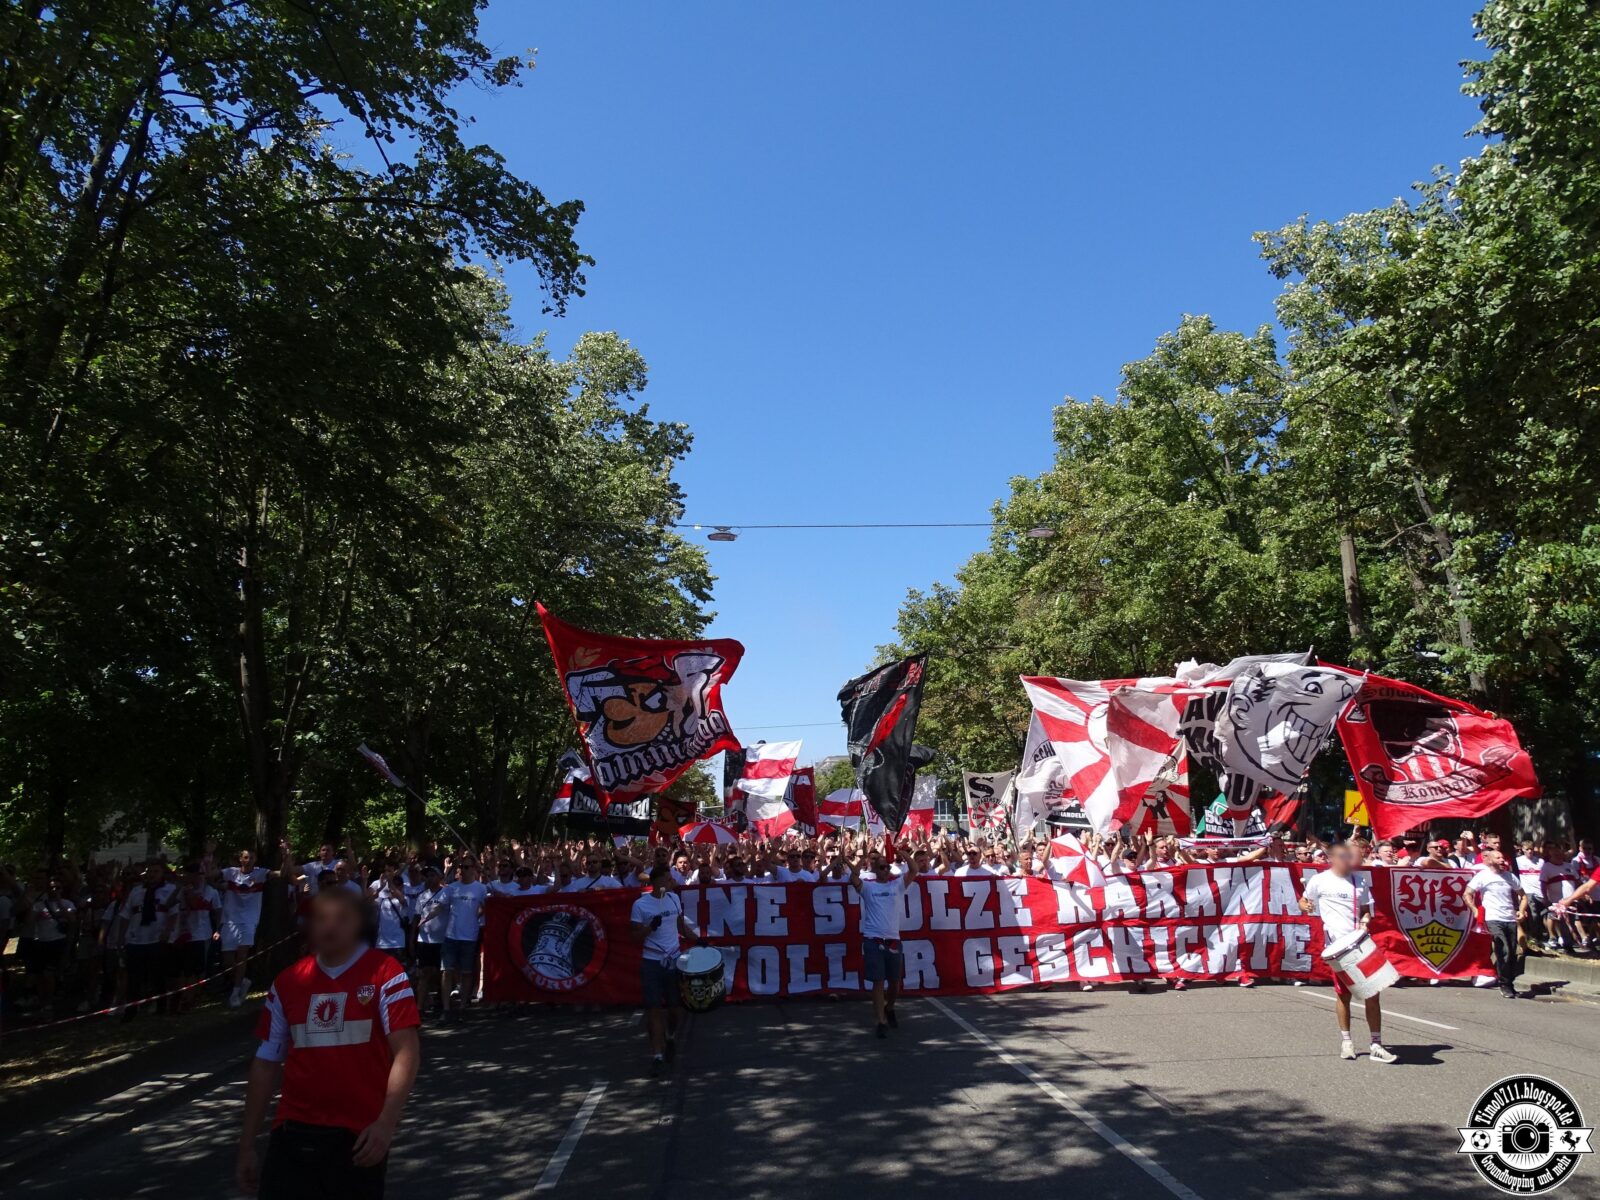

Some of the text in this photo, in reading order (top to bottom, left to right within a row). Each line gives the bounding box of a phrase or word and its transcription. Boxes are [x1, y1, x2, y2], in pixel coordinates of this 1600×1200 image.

[596, 710, 726, 787] ommando
[680, 886, 788, 937] INE
[811, 878, 1033, 936] SOLZE
[963, 922, 1312, 988] GESCHICHTE
